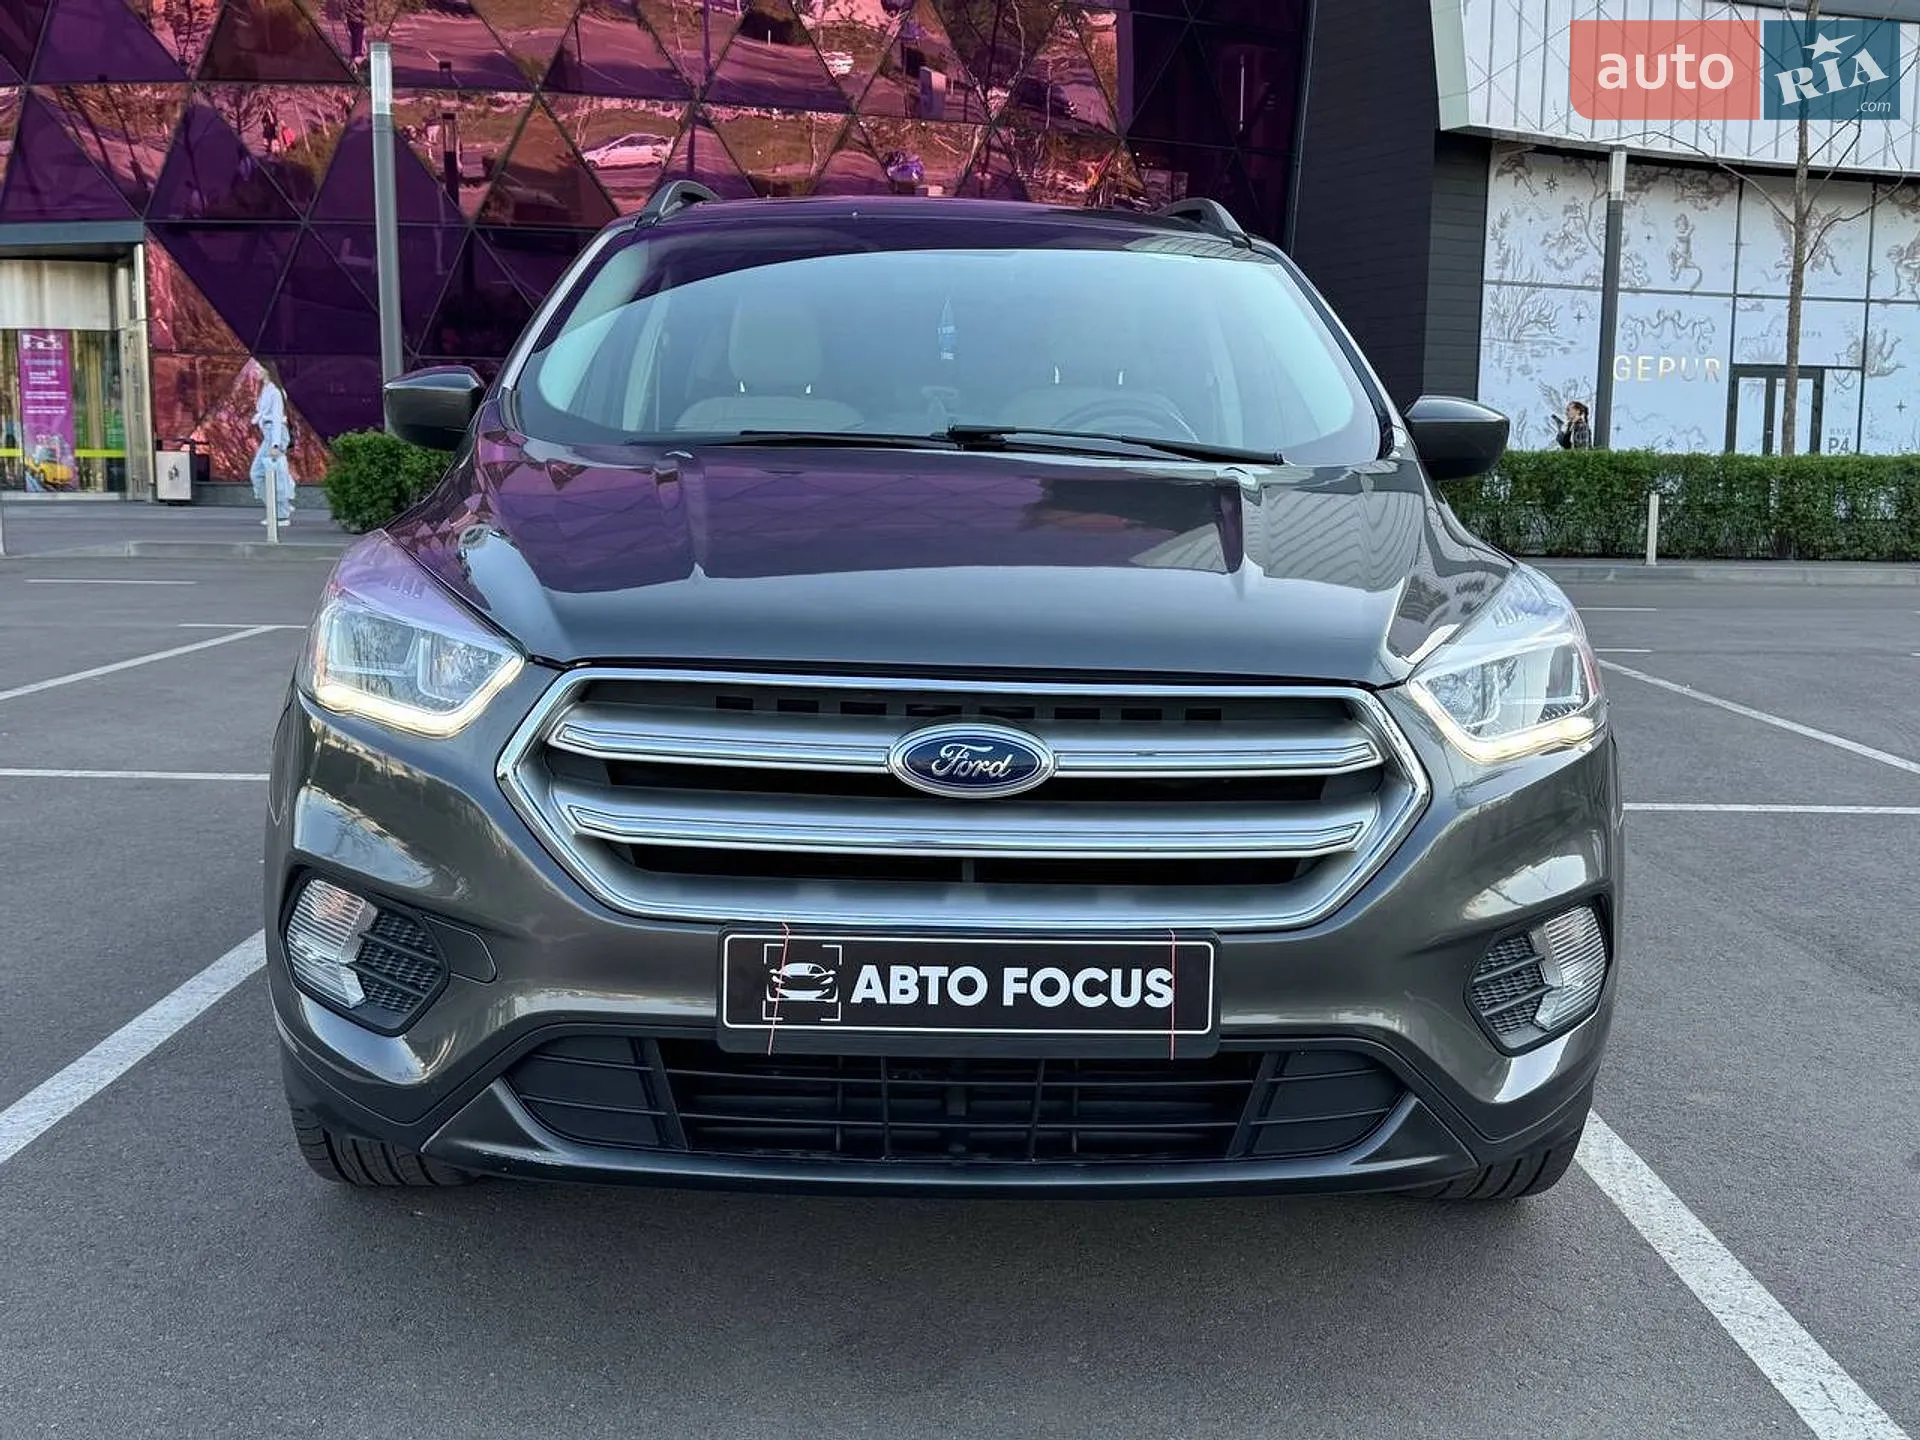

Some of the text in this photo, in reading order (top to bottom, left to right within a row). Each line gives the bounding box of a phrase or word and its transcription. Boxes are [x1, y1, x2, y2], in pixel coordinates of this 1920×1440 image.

[1613, 355, 1720, 382] GEPUR
[931, 743, 1013, 777] Ford
[1002, 967, 1174, 1008] FOCUS
